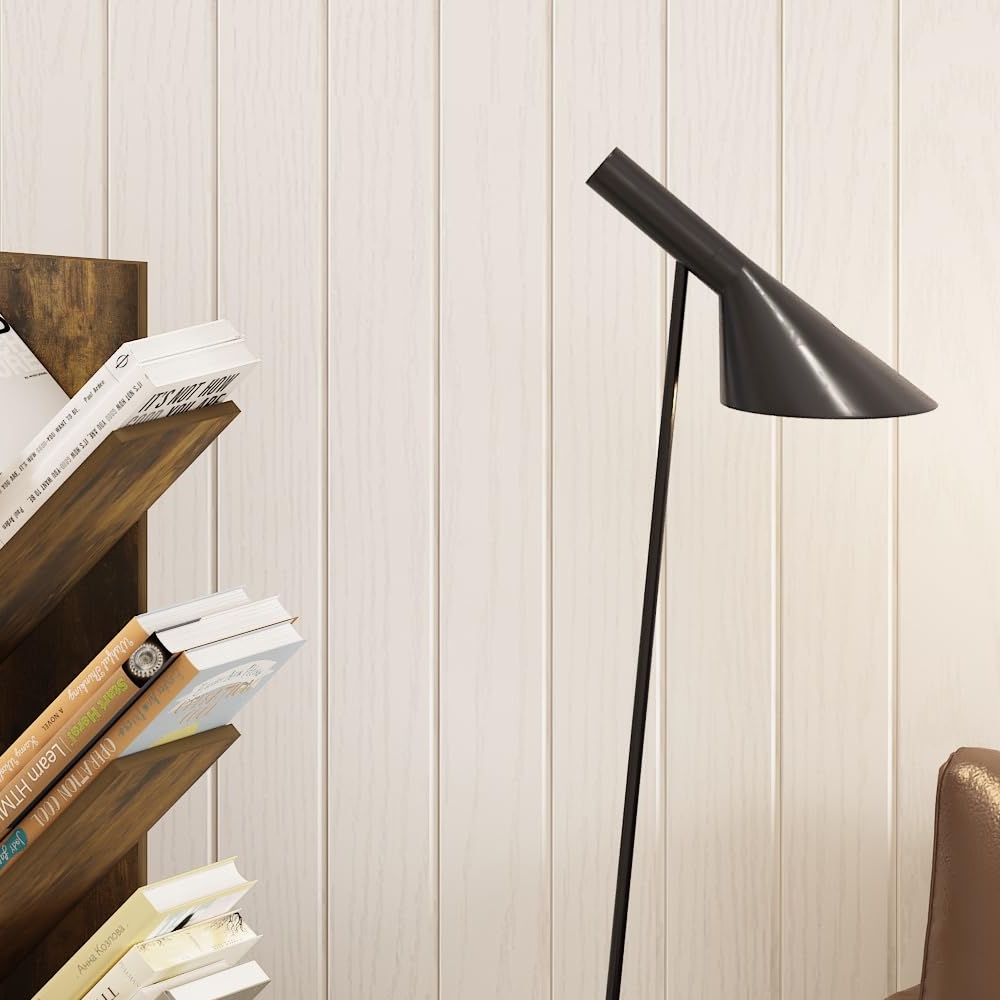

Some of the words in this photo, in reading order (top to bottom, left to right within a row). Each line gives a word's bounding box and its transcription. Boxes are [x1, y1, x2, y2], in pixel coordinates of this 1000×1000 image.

[115, 399, 126, 411] HOW
[125, 388, 135, 400] NOT
[138, 388, 176, 413] IT'S
[167, 381, 207, 405] NOT
[197, 372, 240, 398] HOW
[98, 420, 108, 431] YOU
[1, 479, 11, 490] YOU
[55, 419, 67, 433] WANT
[40, 477, 52, 491] WANT
[97, 677, 129, 710] Start
[42, 712, 60, 731] NOVEL
[27, 743, 67, 782] Learn
[58, 737, 117, 801] OPERATION
[30, 795, 61, 827] COOL
[77, 955, 98, 974] Анна
[96, 925, 126, 955] Козлова
